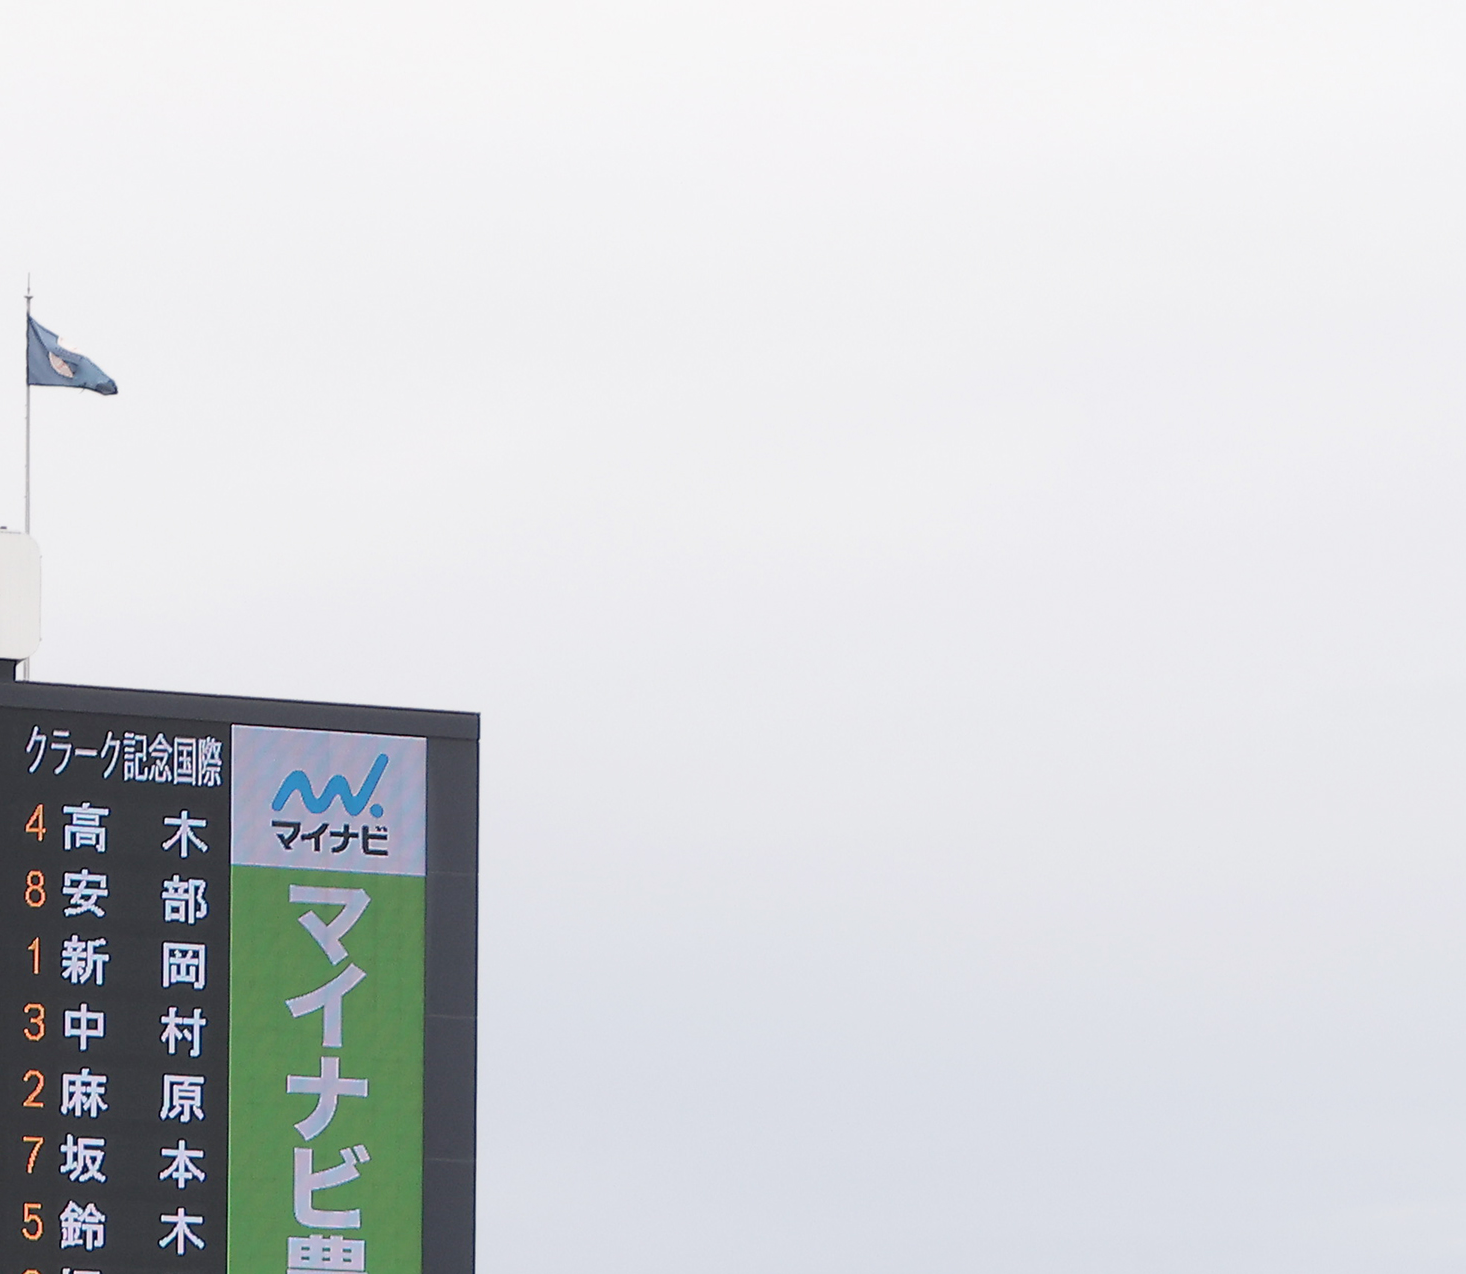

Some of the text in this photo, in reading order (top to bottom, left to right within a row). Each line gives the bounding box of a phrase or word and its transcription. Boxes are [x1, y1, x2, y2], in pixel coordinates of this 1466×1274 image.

[27, 726, 222, 786] クラーク記念国際
[26, 803, 207, 858] 4 高木
[271, 820, 389, 857] マイナビ
[25, 869, 207, 924] 8 安部
[28, 935, 205, 989] 1 新岡
[24, 1004, 206, 1057] 3 中村
[23, 1068, 204, 1122] 2 麻原
[23, 1134, 205, 1188] 7 坂本
[22, 1201, 204, 1255] 5 鈴木
